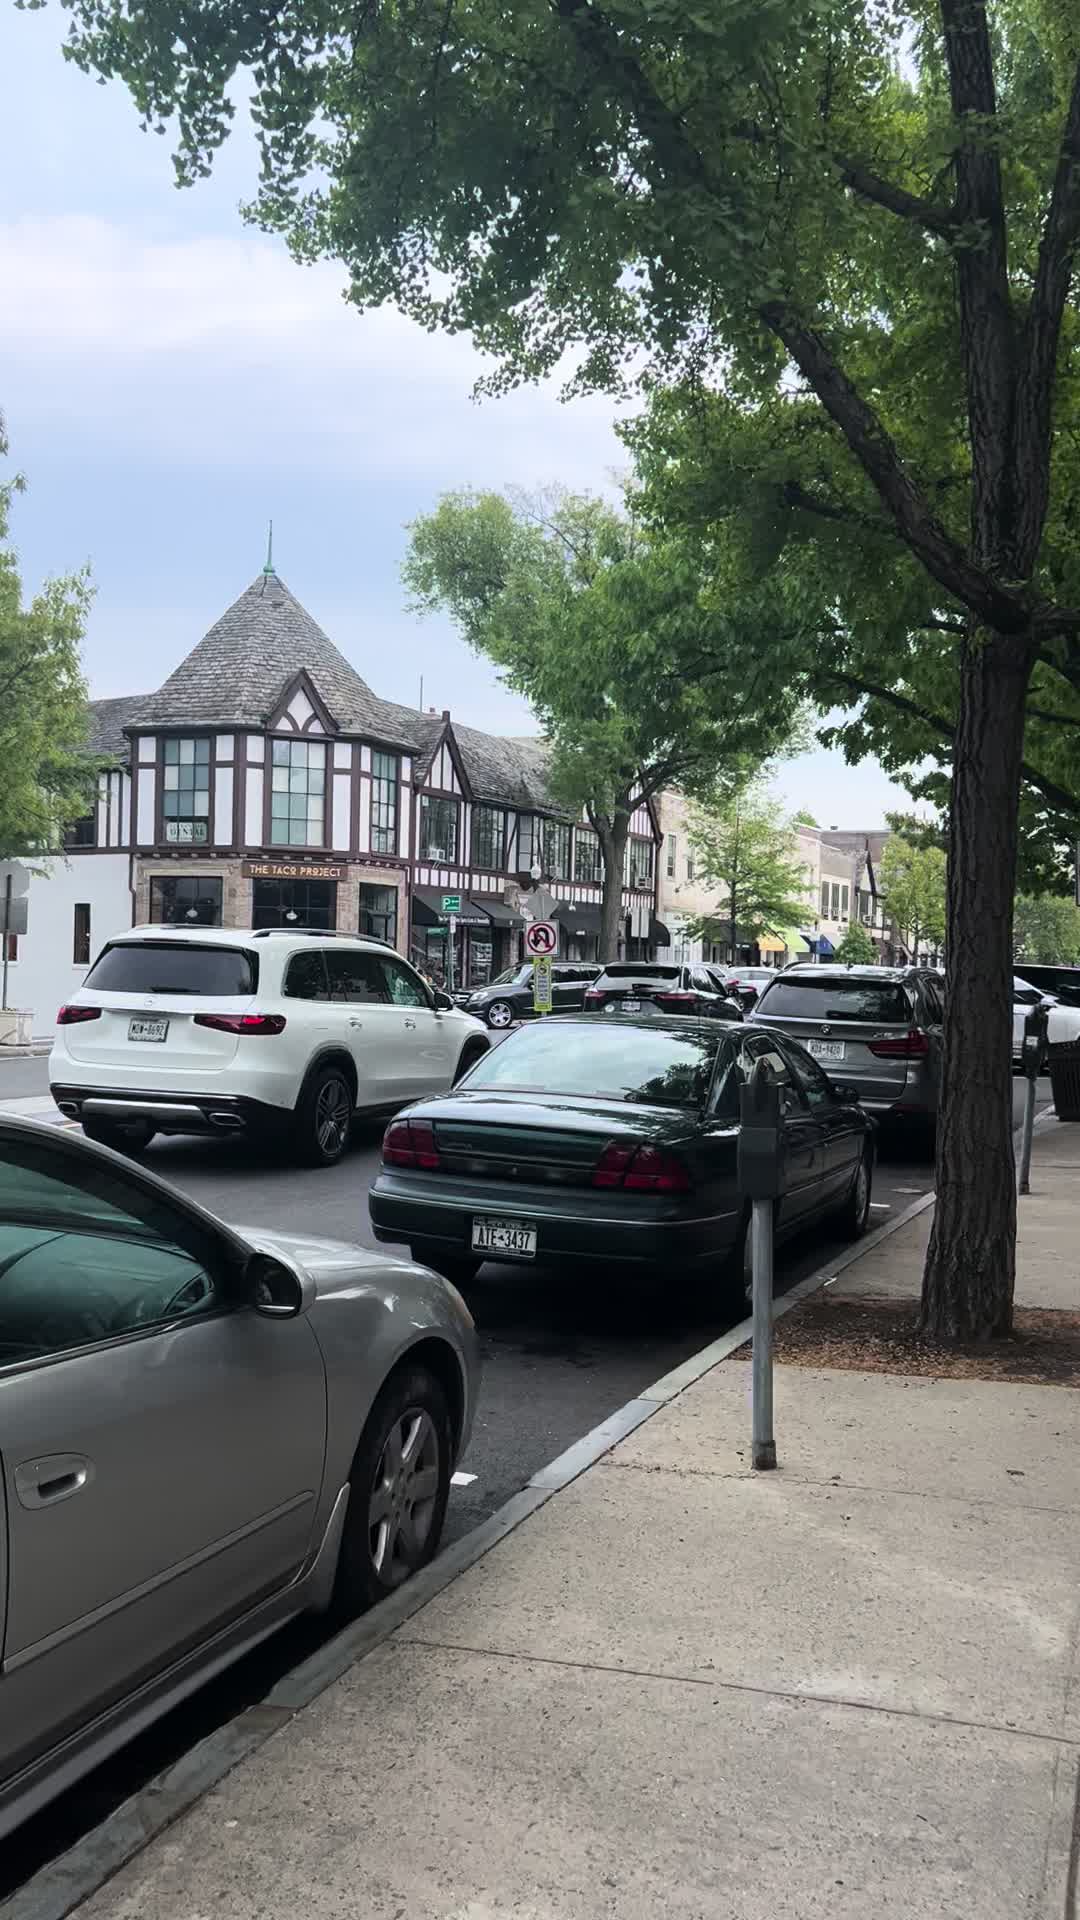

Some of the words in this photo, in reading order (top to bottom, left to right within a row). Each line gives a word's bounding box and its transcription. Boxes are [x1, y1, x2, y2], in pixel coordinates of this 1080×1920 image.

[249, 864, 269, 874] THE
[272, 865, 297, 876] TACO
[300, 866, 341, 877] PROJECT
